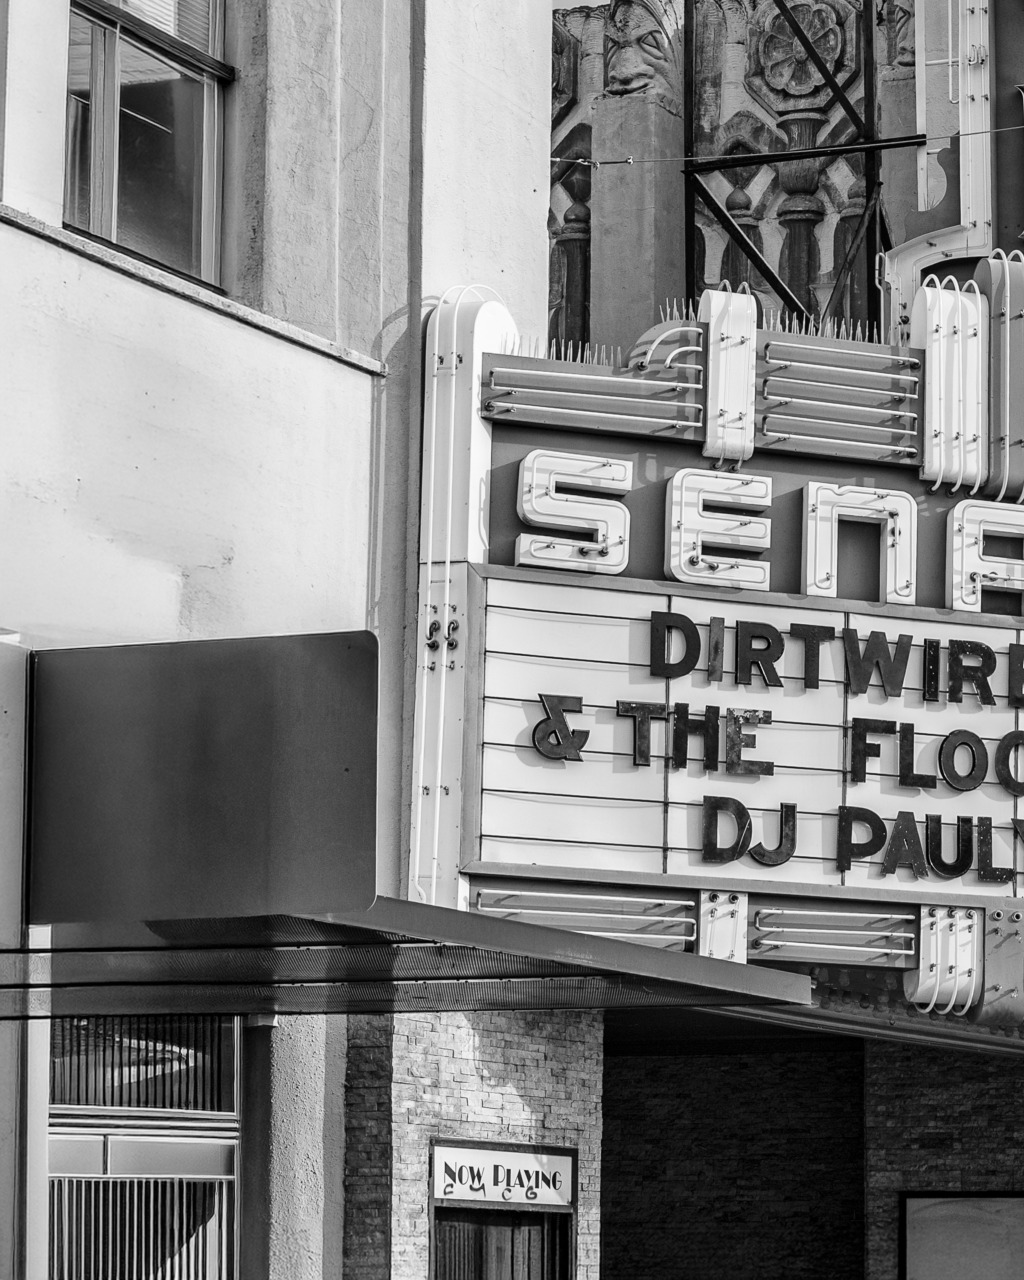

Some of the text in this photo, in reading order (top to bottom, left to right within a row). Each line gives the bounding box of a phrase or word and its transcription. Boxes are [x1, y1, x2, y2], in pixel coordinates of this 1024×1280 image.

[531, 692, 591, 762] &
[616, 699, 775, 776] THE
[701, 795, 798, 866] DJ
